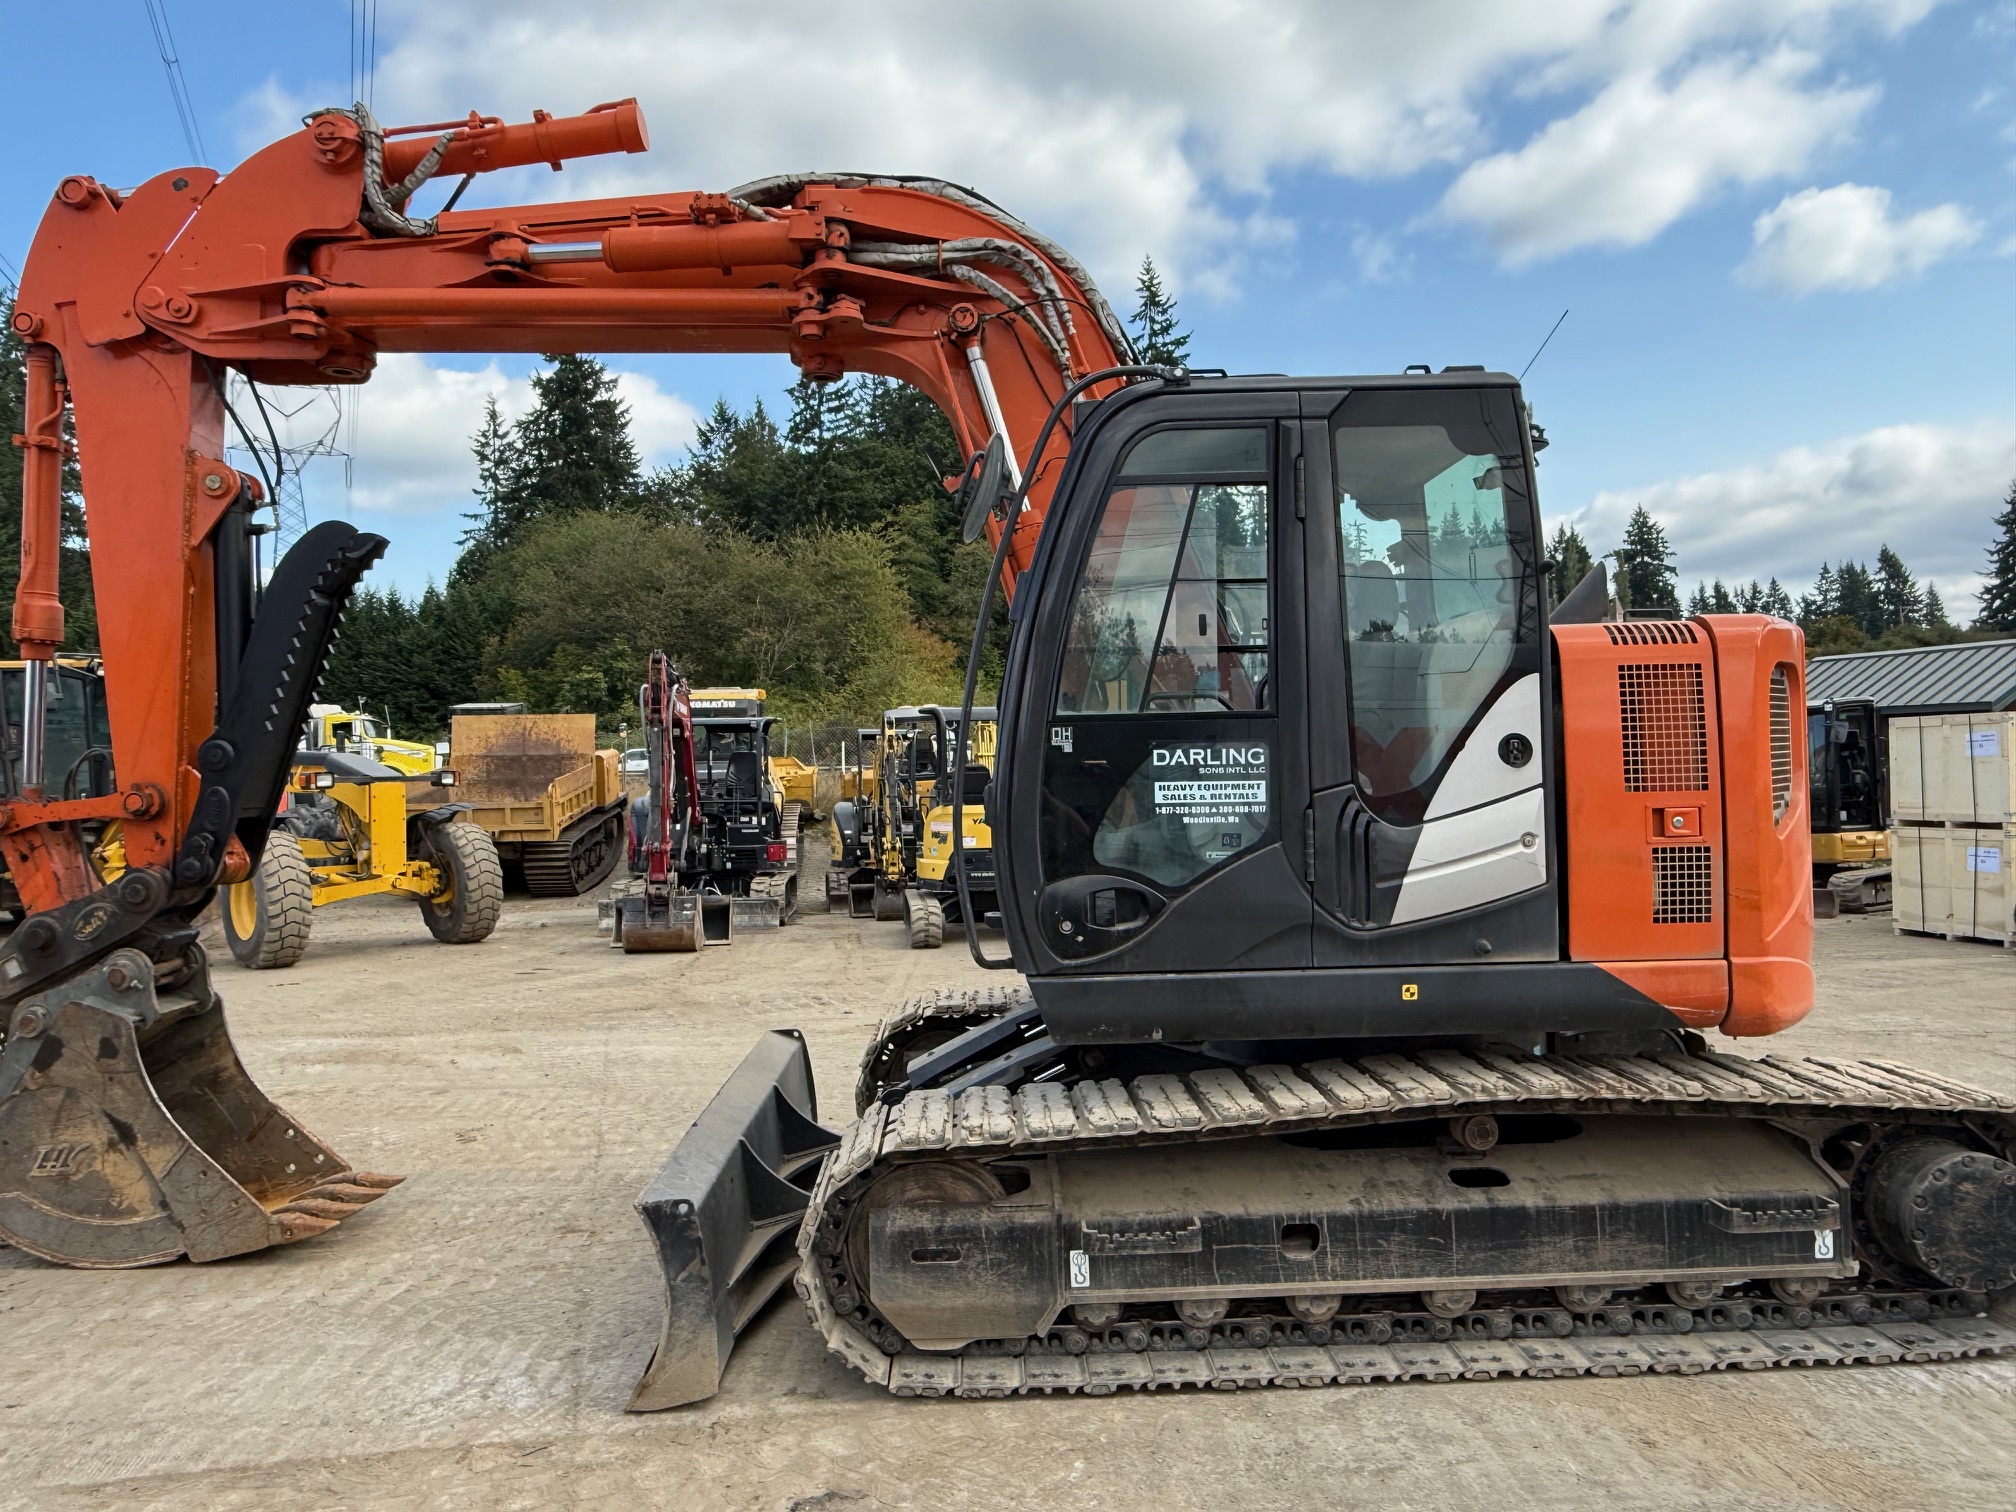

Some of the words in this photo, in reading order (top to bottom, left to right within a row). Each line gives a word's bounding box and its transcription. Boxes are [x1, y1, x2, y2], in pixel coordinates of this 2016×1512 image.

[1153, 748, 1265, 766] DARLING
[1158, 784, 1195, 792] HEAVY
[1197, 783, 1262, 791] EQUIPMENT
[1161, 793, 1197, 801] SALES
[1209, 792, 1259, 800] RENTALS
